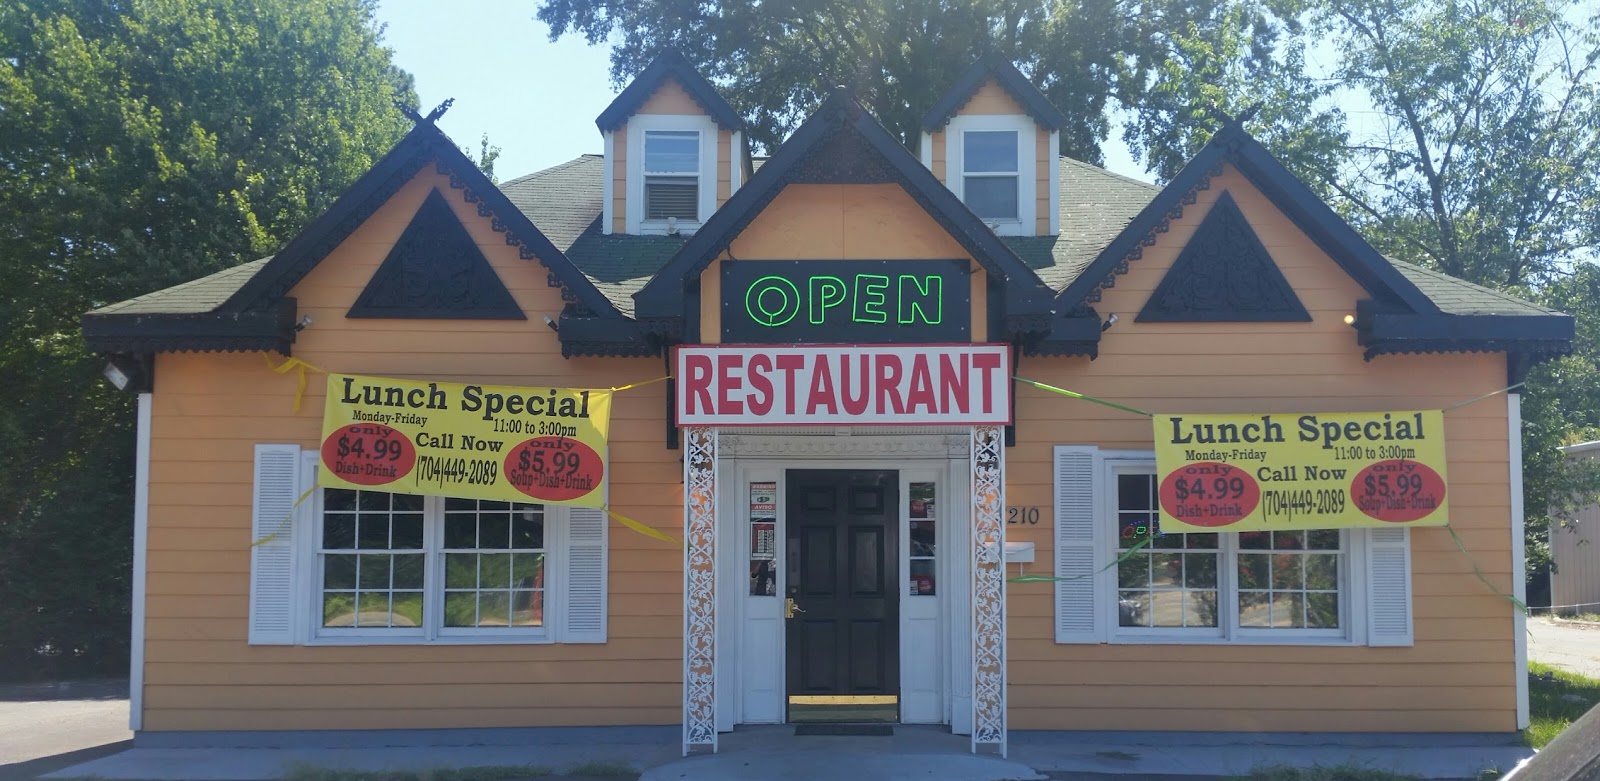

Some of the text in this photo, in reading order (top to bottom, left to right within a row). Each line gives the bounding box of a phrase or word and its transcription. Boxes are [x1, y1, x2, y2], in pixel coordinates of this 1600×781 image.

[746, 274, 942, 327] OPEN
[684, 353, 1001, 416] RESTAURANT
[341, 377, 590, 421] Lunch Special
[352, 410, 428, 427] Monday-Friday
[349, 425, 393, 438] only
[493, 419, 577, 439] 11:00 to 3:00pm
[1170, 413, 1425, 449] Lunch Special
[337, 435, 402, 462] $4.99
[415, 432, 504, 452] Call Now
[529, 440, 575, 452] only
[518, 448, 580, 475] $5.99
[1185, 450, 1266, 462] Monday-Friday
[1334, 446, 1415, 462] 11:00 to 3:00pm
[335, 461, 397, 478] Dish+Drink
[416, 455, 497, 488] (704)449-2089
[1185, 465, 1232, 476] only
[1257, 466, 1347, 482] Call Now
[1372, 462, 1416, 473] only
[510, 470, 592, 491] Soup+Dish+Drink
[1174, 477, 1244, 500] $4.99
[1364, 474, 1422, 497] $5.99
[1176, 503, 1242, 518] Dish+Drink
[1262, 489, 1345, 522] (704)449-2089
[1358, 494, 1436, 514] Soup+Dish+Drink
